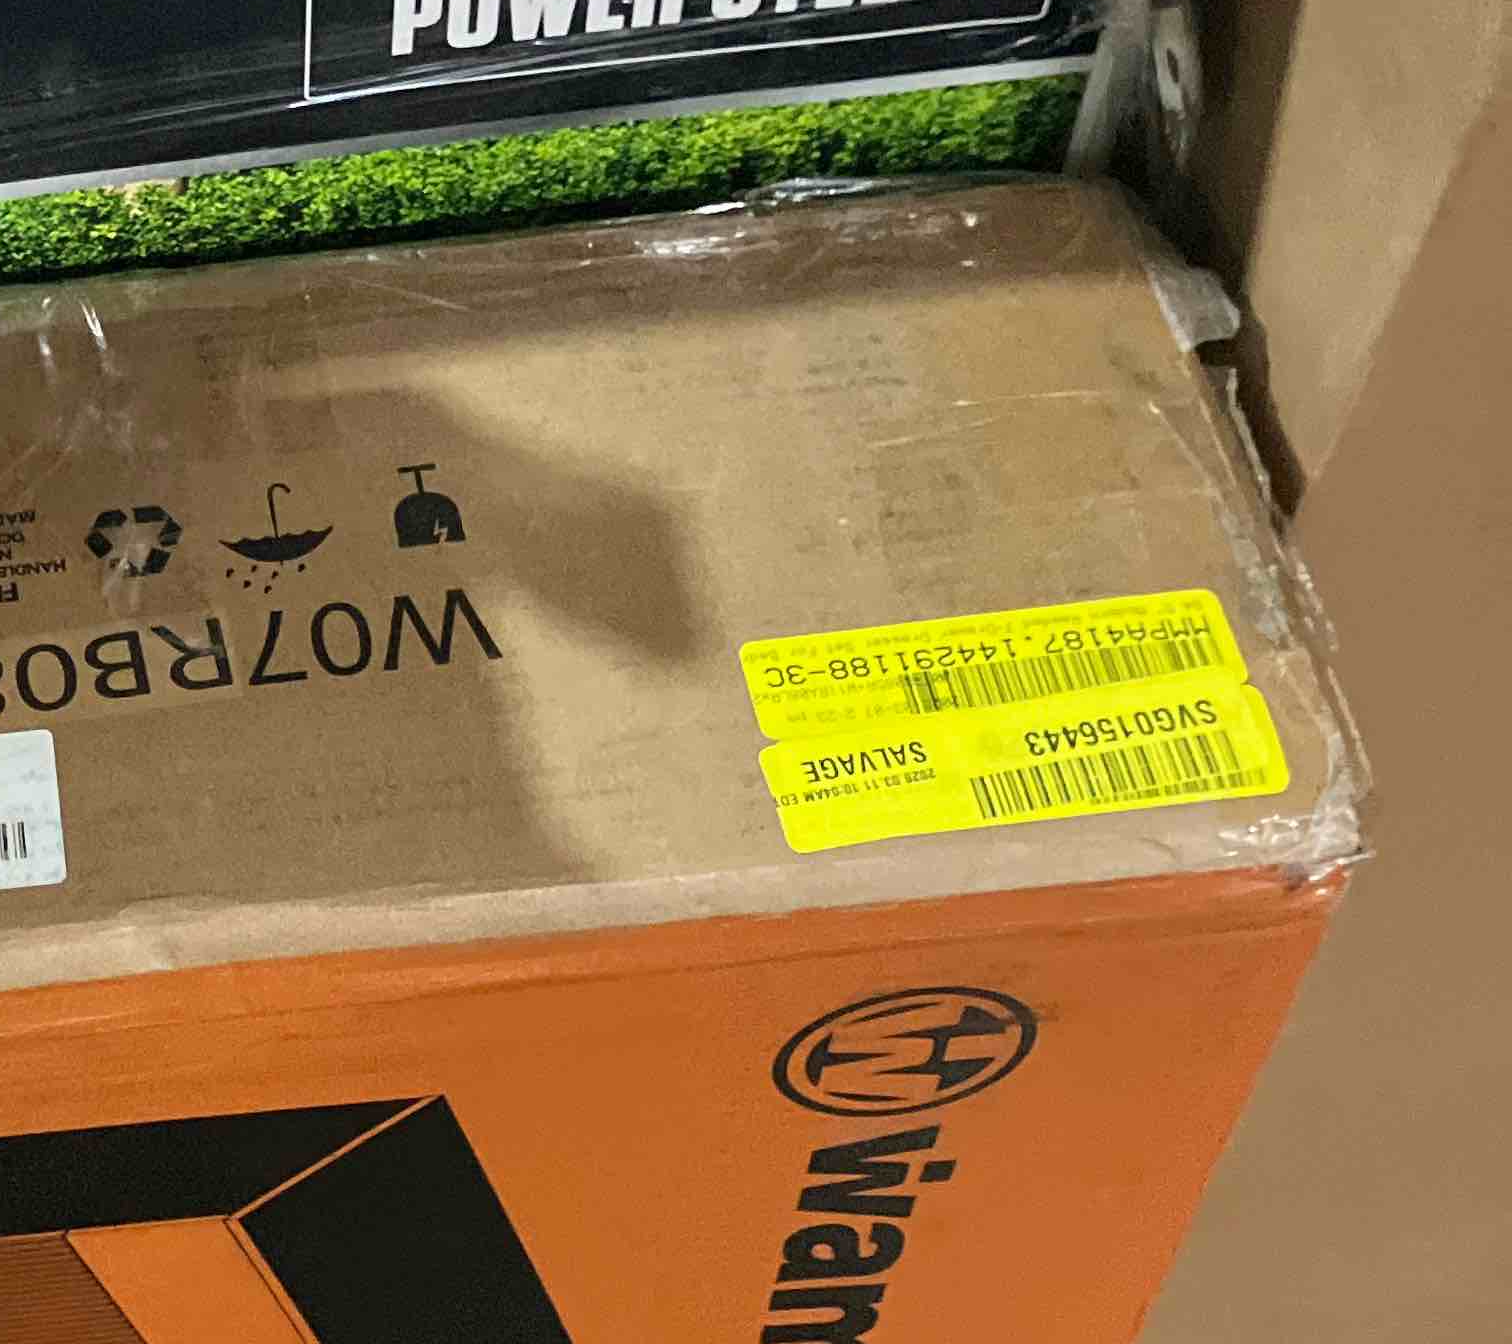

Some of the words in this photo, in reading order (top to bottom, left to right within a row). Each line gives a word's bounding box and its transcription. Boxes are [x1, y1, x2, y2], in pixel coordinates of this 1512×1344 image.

[0, 558, 67, 578] HANDLE
[764, 616, 1210, 688] MMPA4187.144291188-3C
[1024, 699, 1218, 756] SVG0156443
[800, 741, 928, 784] SALVAGE
